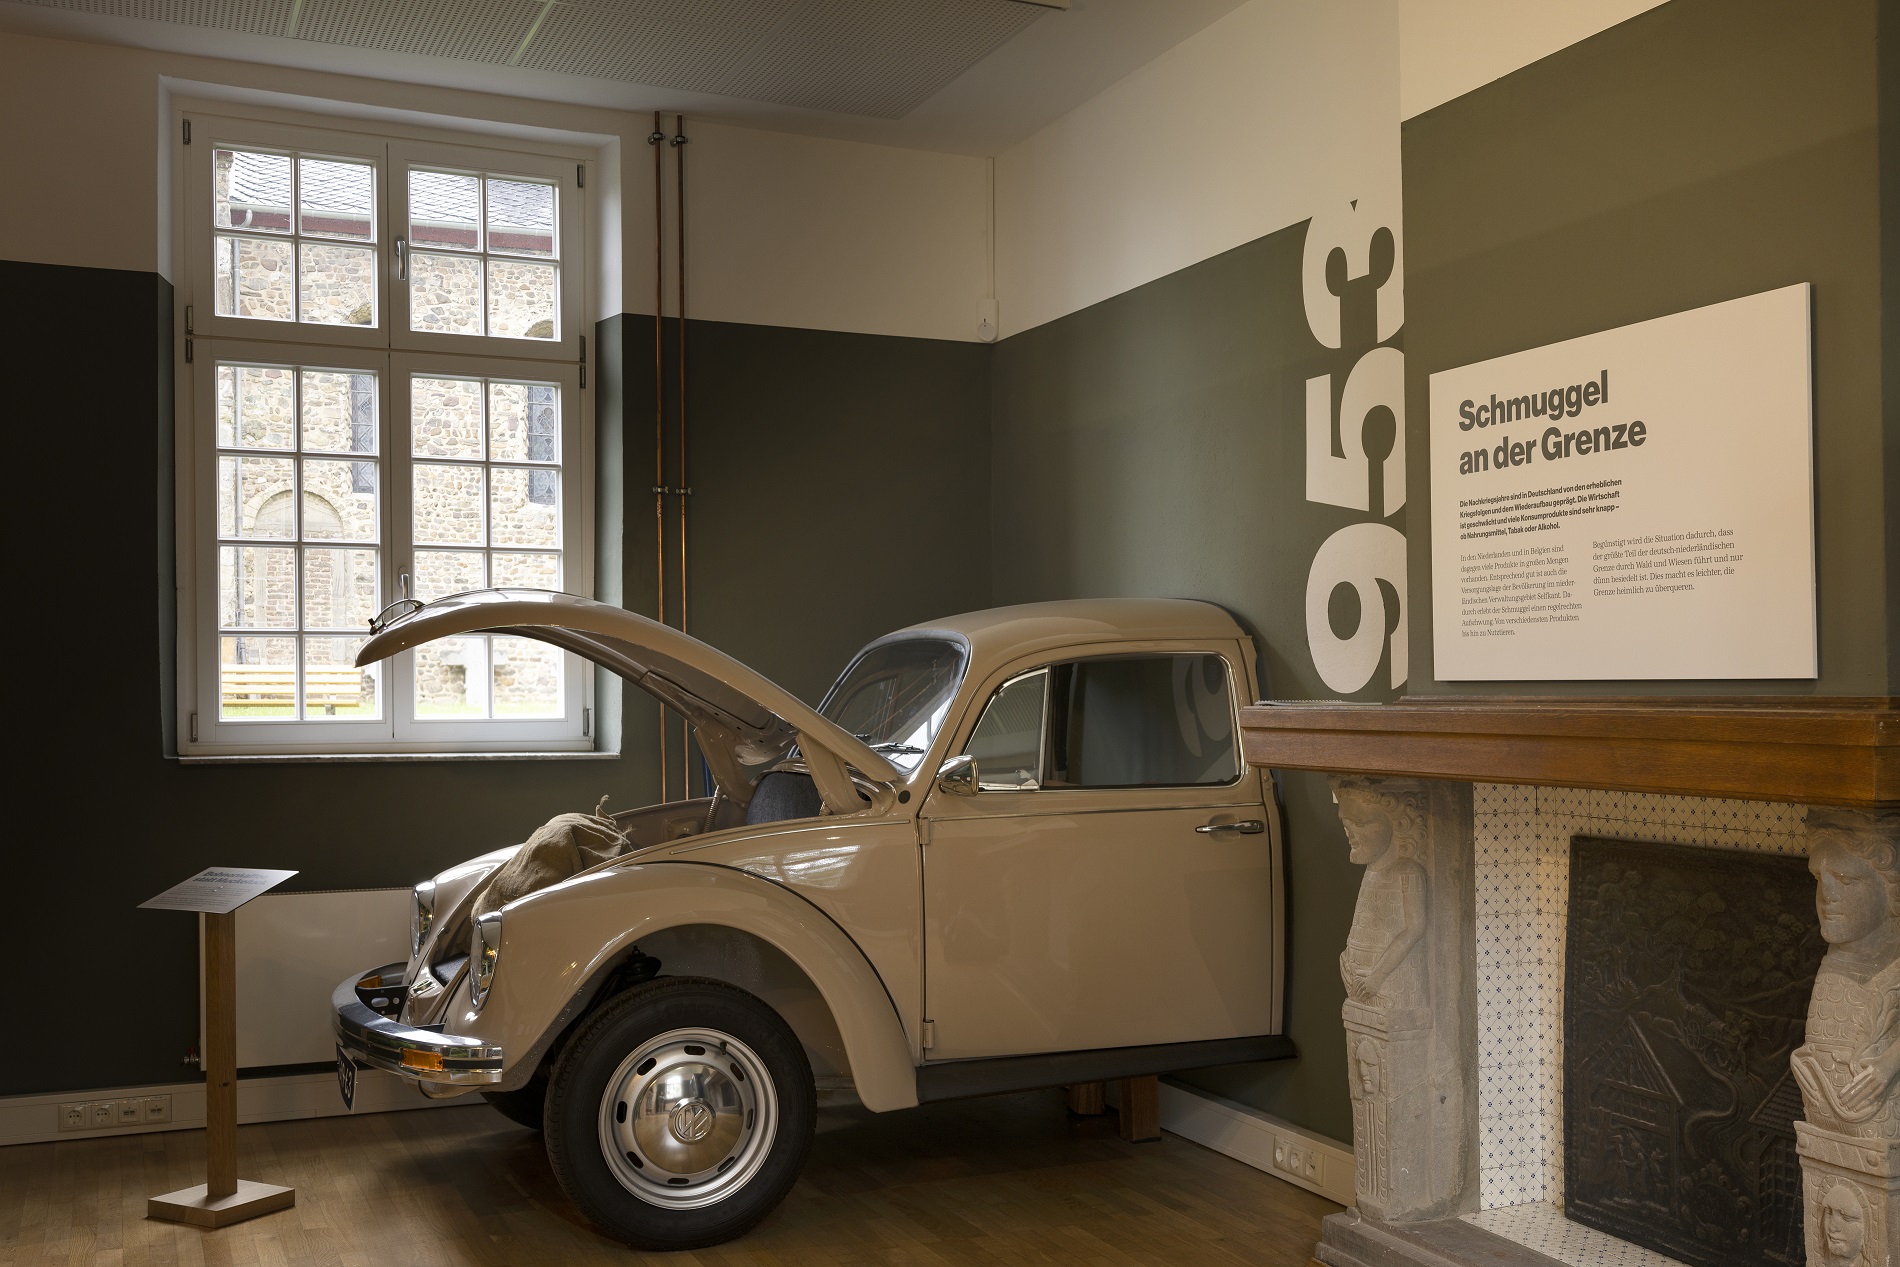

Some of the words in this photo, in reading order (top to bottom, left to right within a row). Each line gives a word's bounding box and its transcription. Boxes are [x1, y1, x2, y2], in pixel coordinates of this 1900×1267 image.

[1459, 369, 1609, 431] Schmuggel
[1459, 447, 1489, 475] an
[1493, 437, 1537, 470] der
[1541, 420, 1647, 461] Grenze
[1469, 495, 1510, 507] Nachkriegsjahre
[1528, 487, 1562, 498] Deutschland
[1586, 479, 1622, 490] erheblichen
[1460, 508, 1491, 518] Kriegsfolgen
[1492, 506, 1501, 514] und
[1502, 504, 1514, 513] dem
[1514, 499, 1552, 511] Wiederaufbau
[1553, 496, 1576, 507] geprägt.
[1588, 491, 1620, 501] Wirtschaft
[1520, 510, 1568, 522] Konsumprodukte
[1582, 506, 1595, 514] sehr
[1596, 504, 1614, 513] knapp
[1508, 526, 1523, 534] Tabak
[1538, 522, 1560, 531] Alkohol.
[1593, 539, 1626, 549] Begünstigt
[1627, 537, 1642, 545] wird
[1655, 533, 1684, 543] Situation
[1686, 530, 1716, 540] dadurch,
[1625, 550, 1636, 558] Teil
[1638, 548, 1648, 556] der
[1650, 542, 1734, 555] deutsch-niederländischen
[1593, 564, 1615, 572] Grenze
[1616, 562, 1634, 570] durch
[1636, 561, 1652, 569] Wald
[1653, 559, 1666, 567] und
[1668, 557, 1692, 566] Wiesen
[1694, 556, 1712, 564] führt
[1714, 554, 1728, 562] und
[1593, 576, 1610, 584] dünn
[1611, 574, 1638, 583] besiedelt
[1650, 572, 1664, 580] Dies
[1665, 570, 1686, 579] macht
[1696, 568, 1722, 577] leichter,
[1724, 566, 1734, 575] die
[1594, 588, 1615, 596] Grenze
[1617, 586, 1644, 595] heimlich
[1655, 583, 1695, 593] überqueren.
